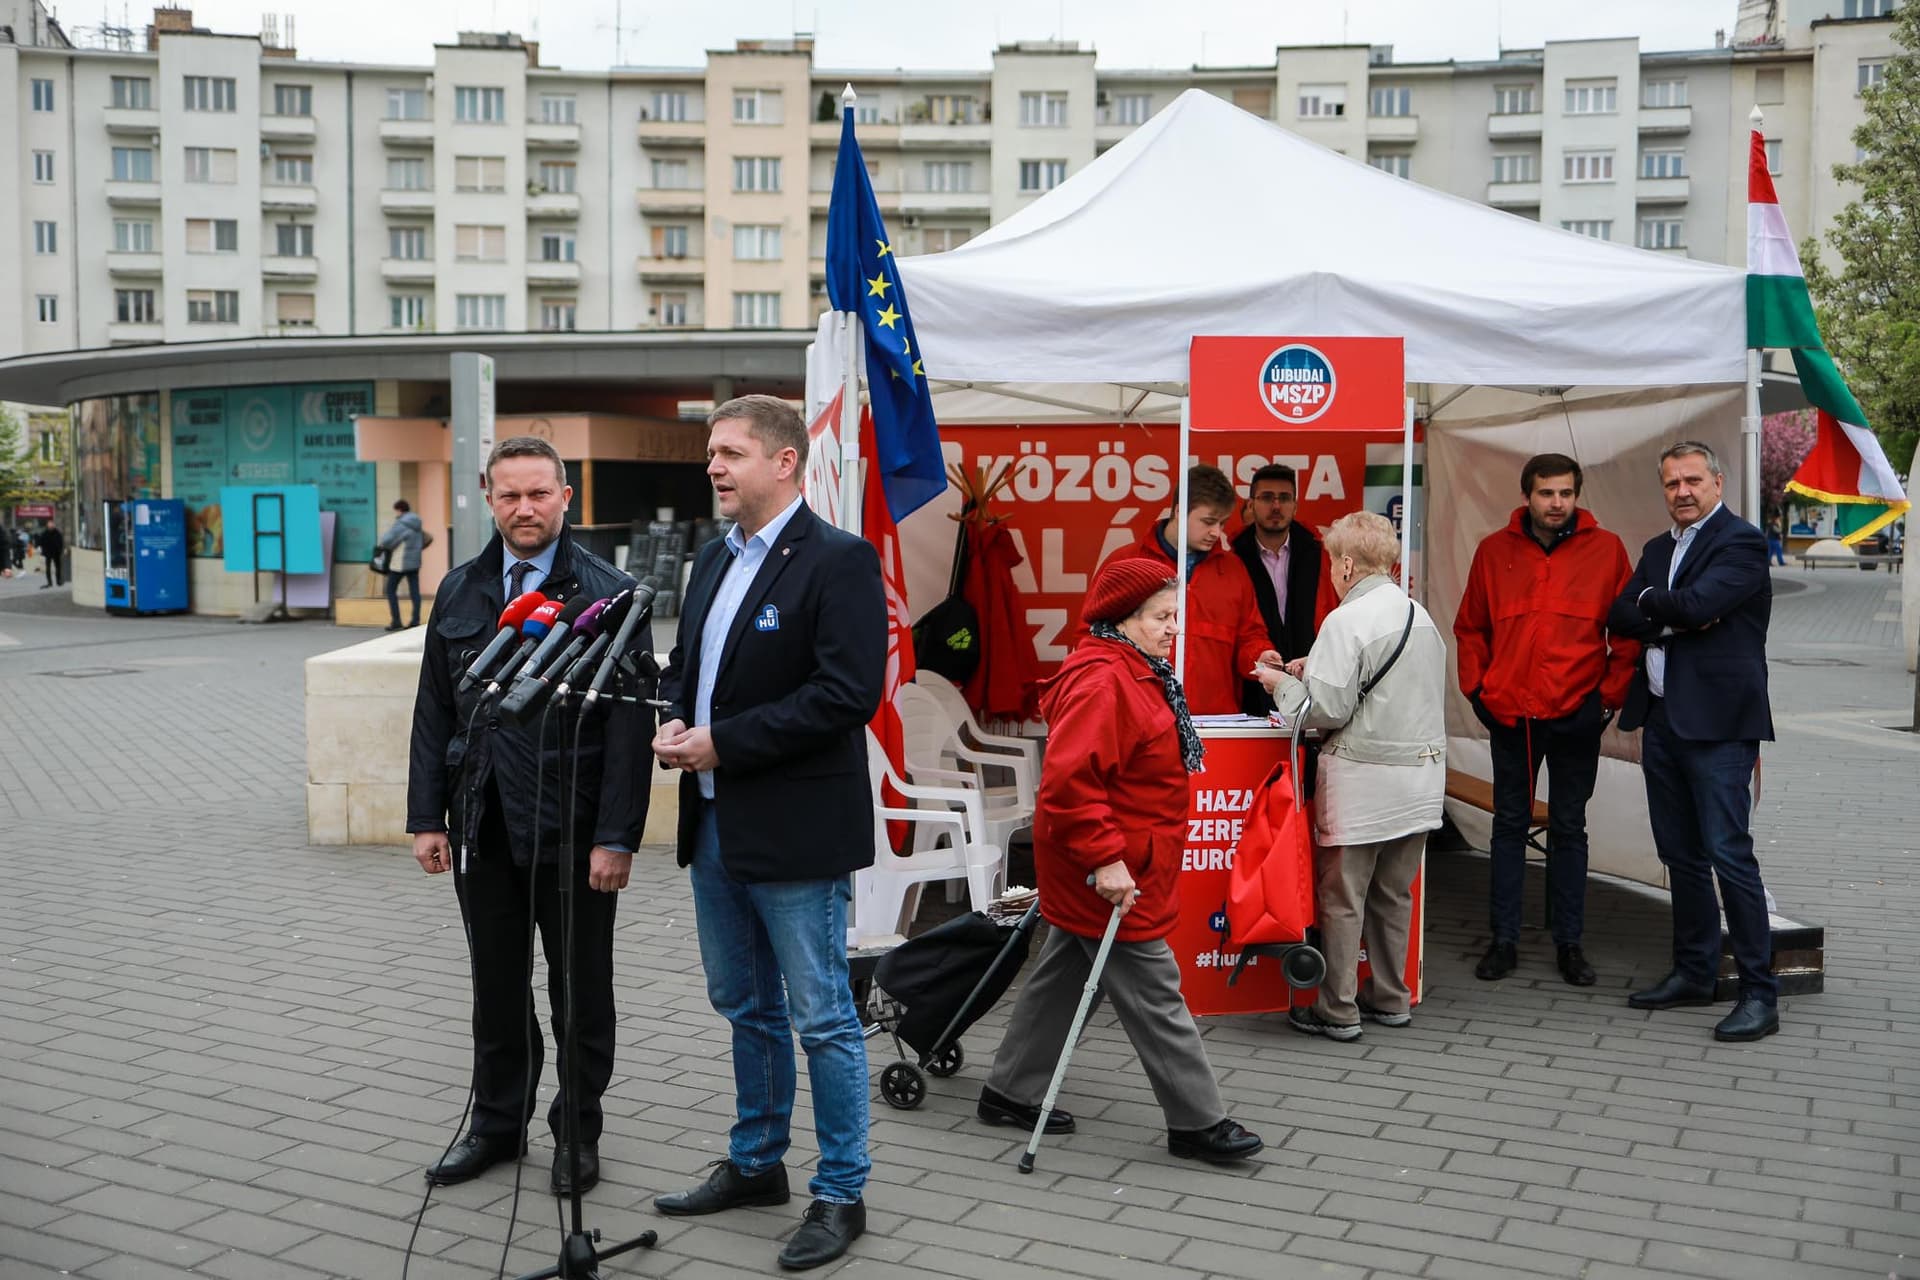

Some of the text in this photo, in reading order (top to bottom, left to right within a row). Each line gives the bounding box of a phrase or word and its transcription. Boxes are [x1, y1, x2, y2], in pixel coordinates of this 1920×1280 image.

[1271, 365, 1324, 383] ÚJBUDAI
[1270, 384, 1325, 404] MSZP
[977, 441, 1171, 502] KÖZÖS
[766, 609, 775, 618] E
[759, 618, 775, 628] HU
